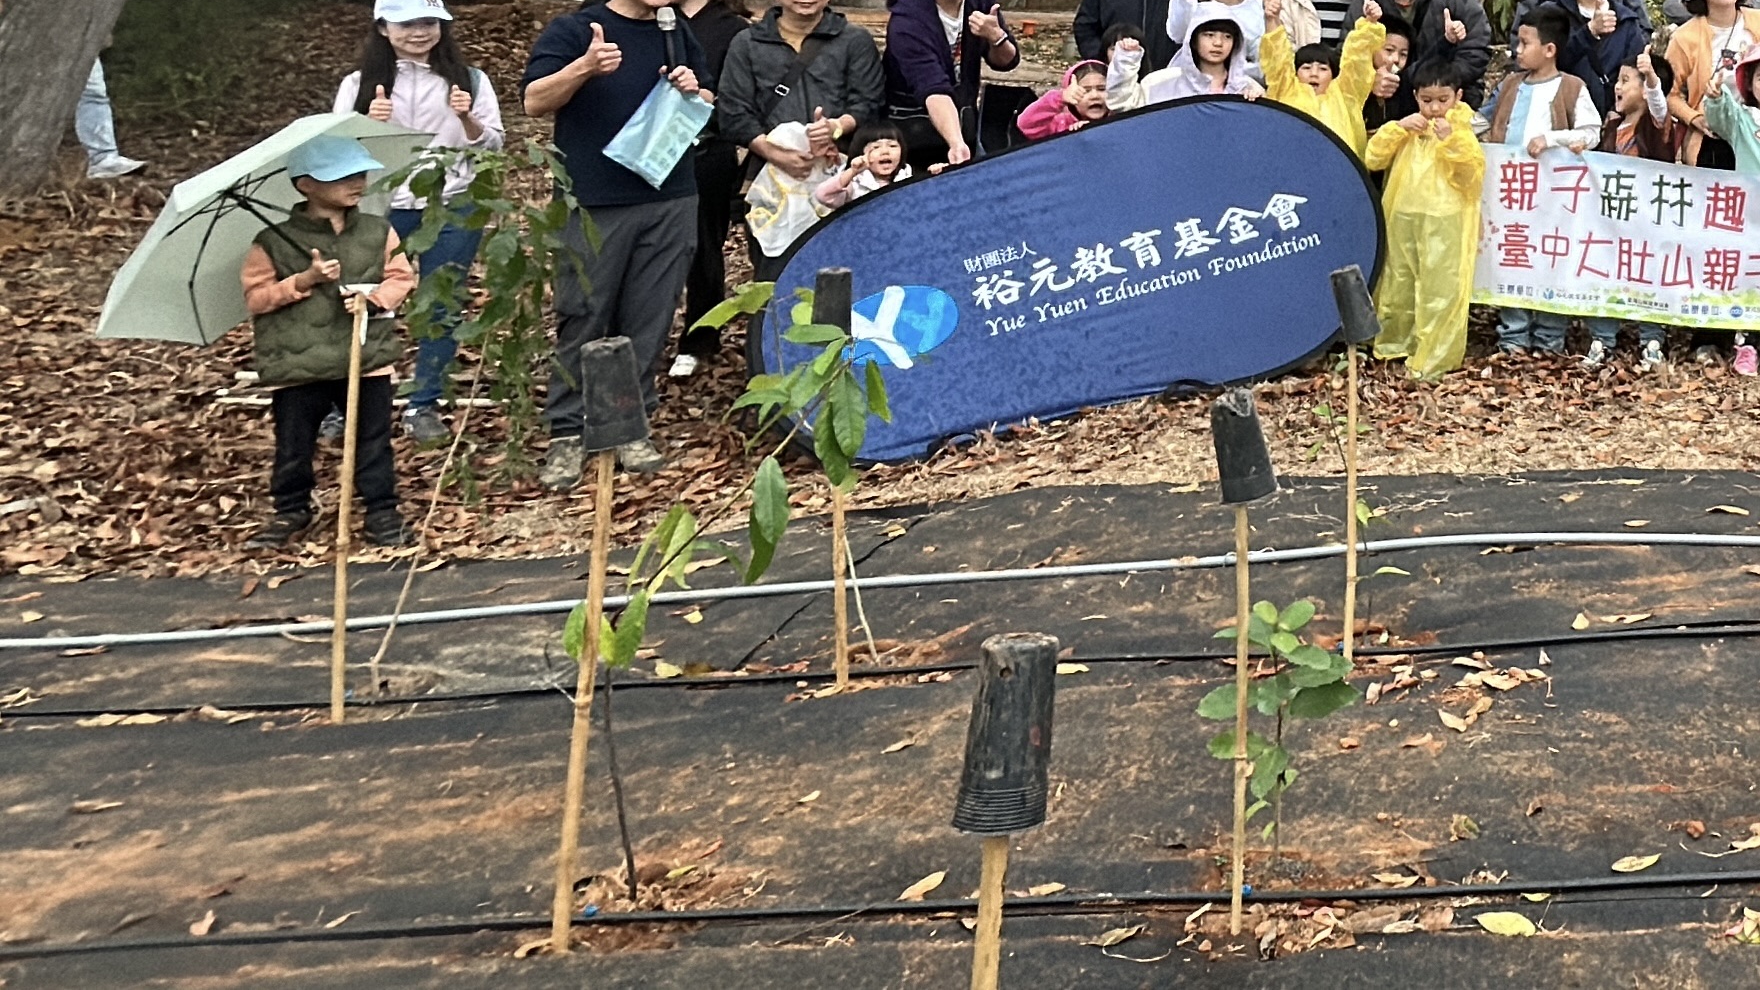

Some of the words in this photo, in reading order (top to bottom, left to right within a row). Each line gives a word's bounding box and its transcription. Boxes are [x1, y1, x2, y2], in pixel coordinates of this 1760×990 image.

[1499, 160, 1747, 233] 親子森林趣
[963, 241, 1037, 274] 財團法人
[972, 193, 1308, 311] 裕元教育基金會
[985, 313, 1026, 336] Yue
[1033, 295, 1088, 323] Yuen
[1095, 266, 1201, 307] Education
[1207, 232, 1321, 277] Foundation
